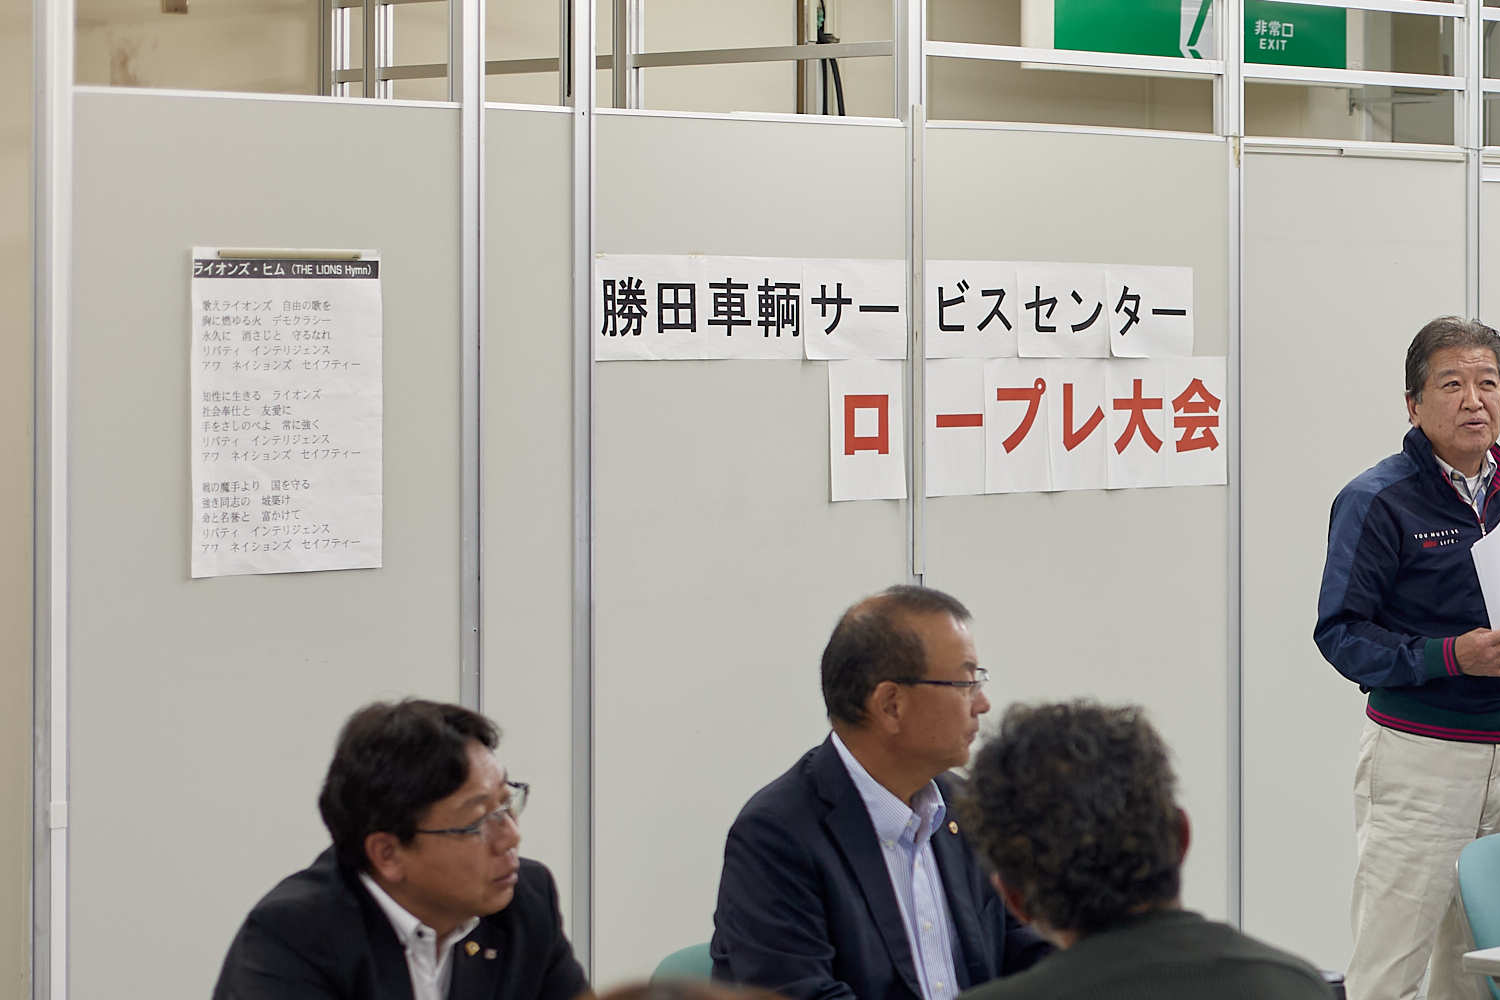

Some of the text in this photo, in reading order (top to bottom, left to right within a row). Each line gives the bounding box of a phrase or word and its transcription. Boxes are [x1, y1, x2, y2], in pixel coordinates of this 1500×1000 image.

[1255, 20, 1294, 37] 非常口
[1259, 39, 1287, 51] EXIT
[194, 262, 285, 276] ライオンズ・ヒム
[316, 265, 342, 275] LIONS
[202, 300, 331, 311] 歌えライオンズ 自由の歌を
[202, 316, 331, 326] 胸に燃ゆる火 デモクラシー
[202, 330, 331, 341] 永久に 消さじと 守るなれ
[252, 345, 330, 356] インテリジェンス
[202, 360, 360, 371] アワ ネイションズ セイフティー
[202, 389, 321, 402] 知性に生きる ライオンズ
[202, 405, 291, 417] 社会奉仕と 友愛に
[282, 419, 320, 430] 常に強く
[251, 434, 330, 446] インテリジェンス
[202, 449, 360, 462] アワ ネイションズ セイフティー
[271, 479, 310, 490] 国を守る
[202, 496, 251, 509] 強き同志の
[202, 509, 300, 524] 命と名誉と 富かけて
[251, 524, 330, 537] インテリジェンス
[202, 538, 360, 554] アワ ネイションズ セイフティー
